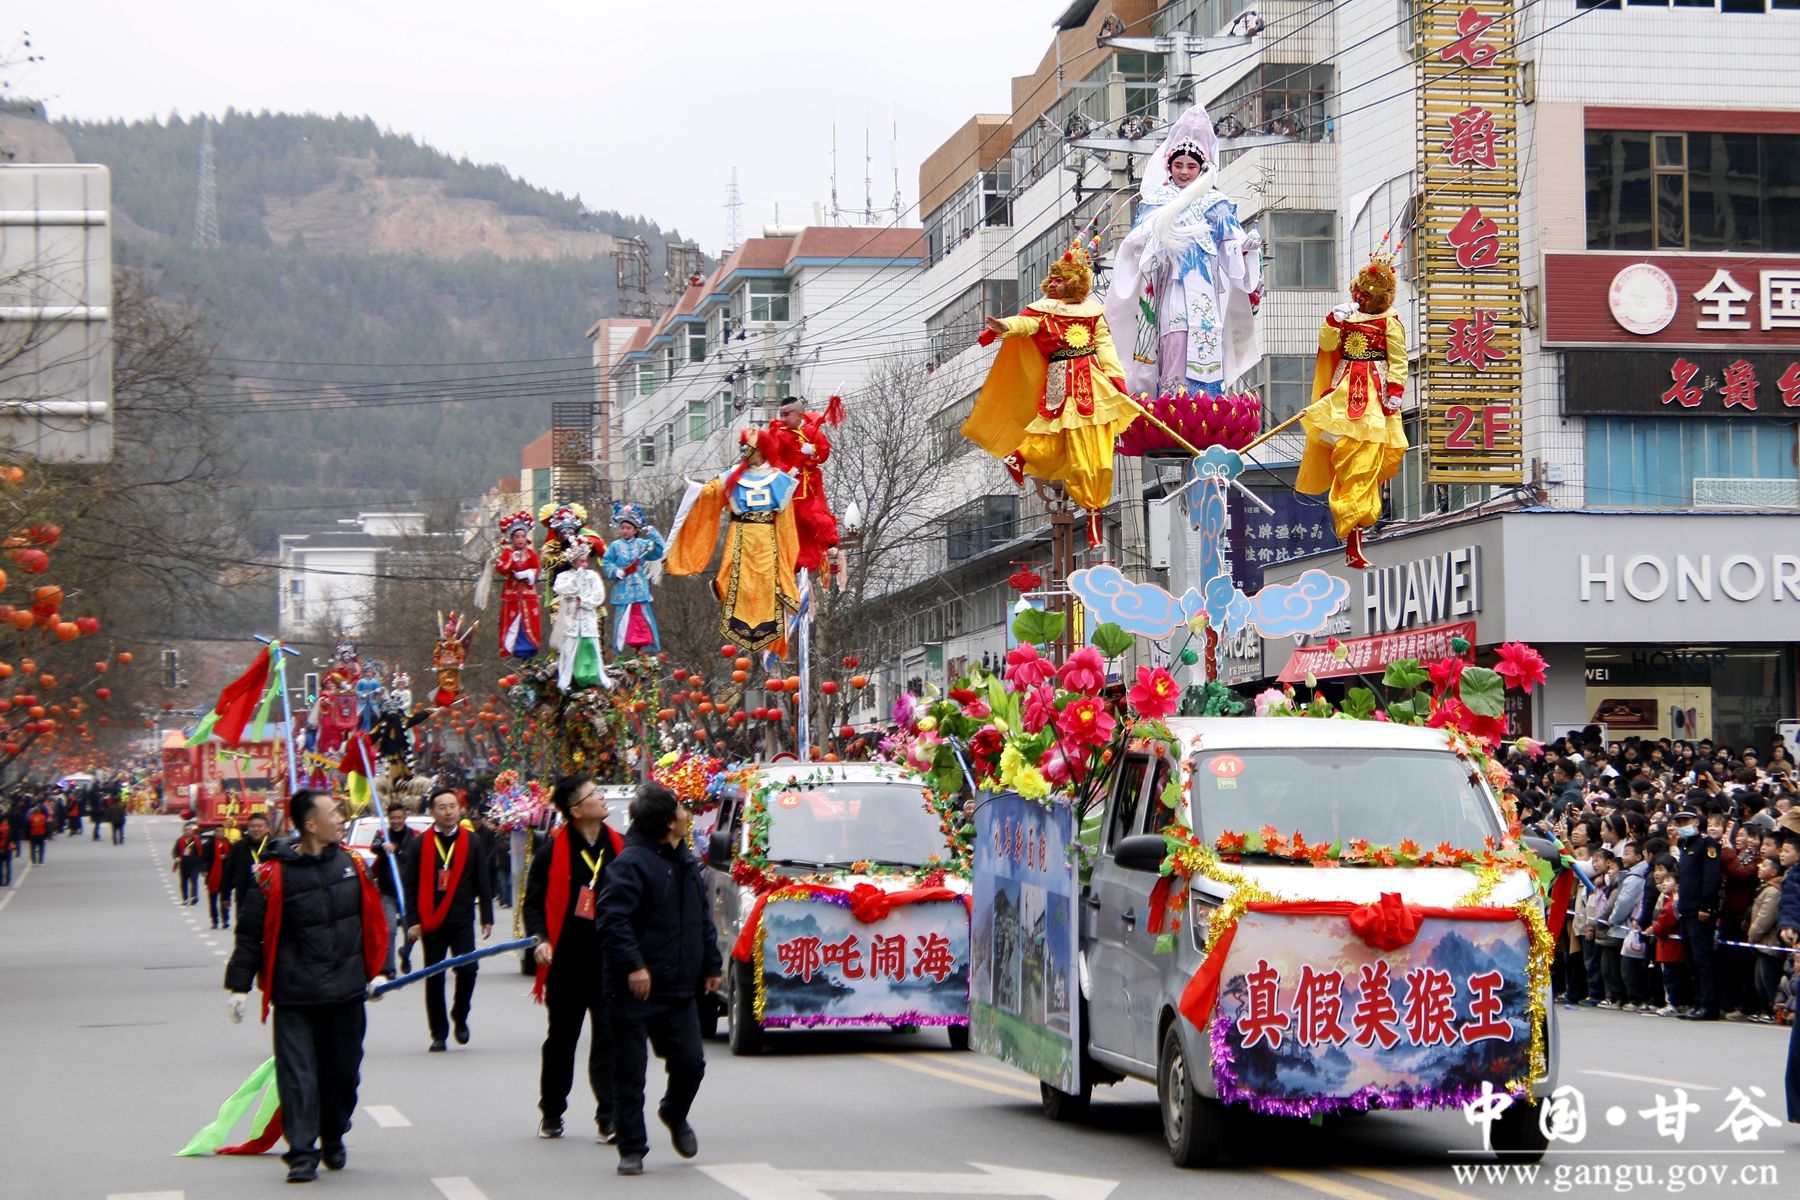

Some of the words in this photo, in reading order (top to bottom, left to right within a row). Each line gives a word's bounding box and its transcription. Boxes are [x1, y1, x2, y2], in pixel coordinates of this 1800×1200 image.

[1440, 7, 1507, 372] 名爵台球
[1445, 405, 1512, 450] 2F
[1363, 545, 1481, 634] HUAWEI
[1580, 554, 1800, 601] HONOR
[1217, 760, 1236, 773] 41
[782, 797, 797, 805] 42
[776, 932, 955, 983] 哪吒闹海
[1237, 959, 1514, 1049] 真假美猴王
